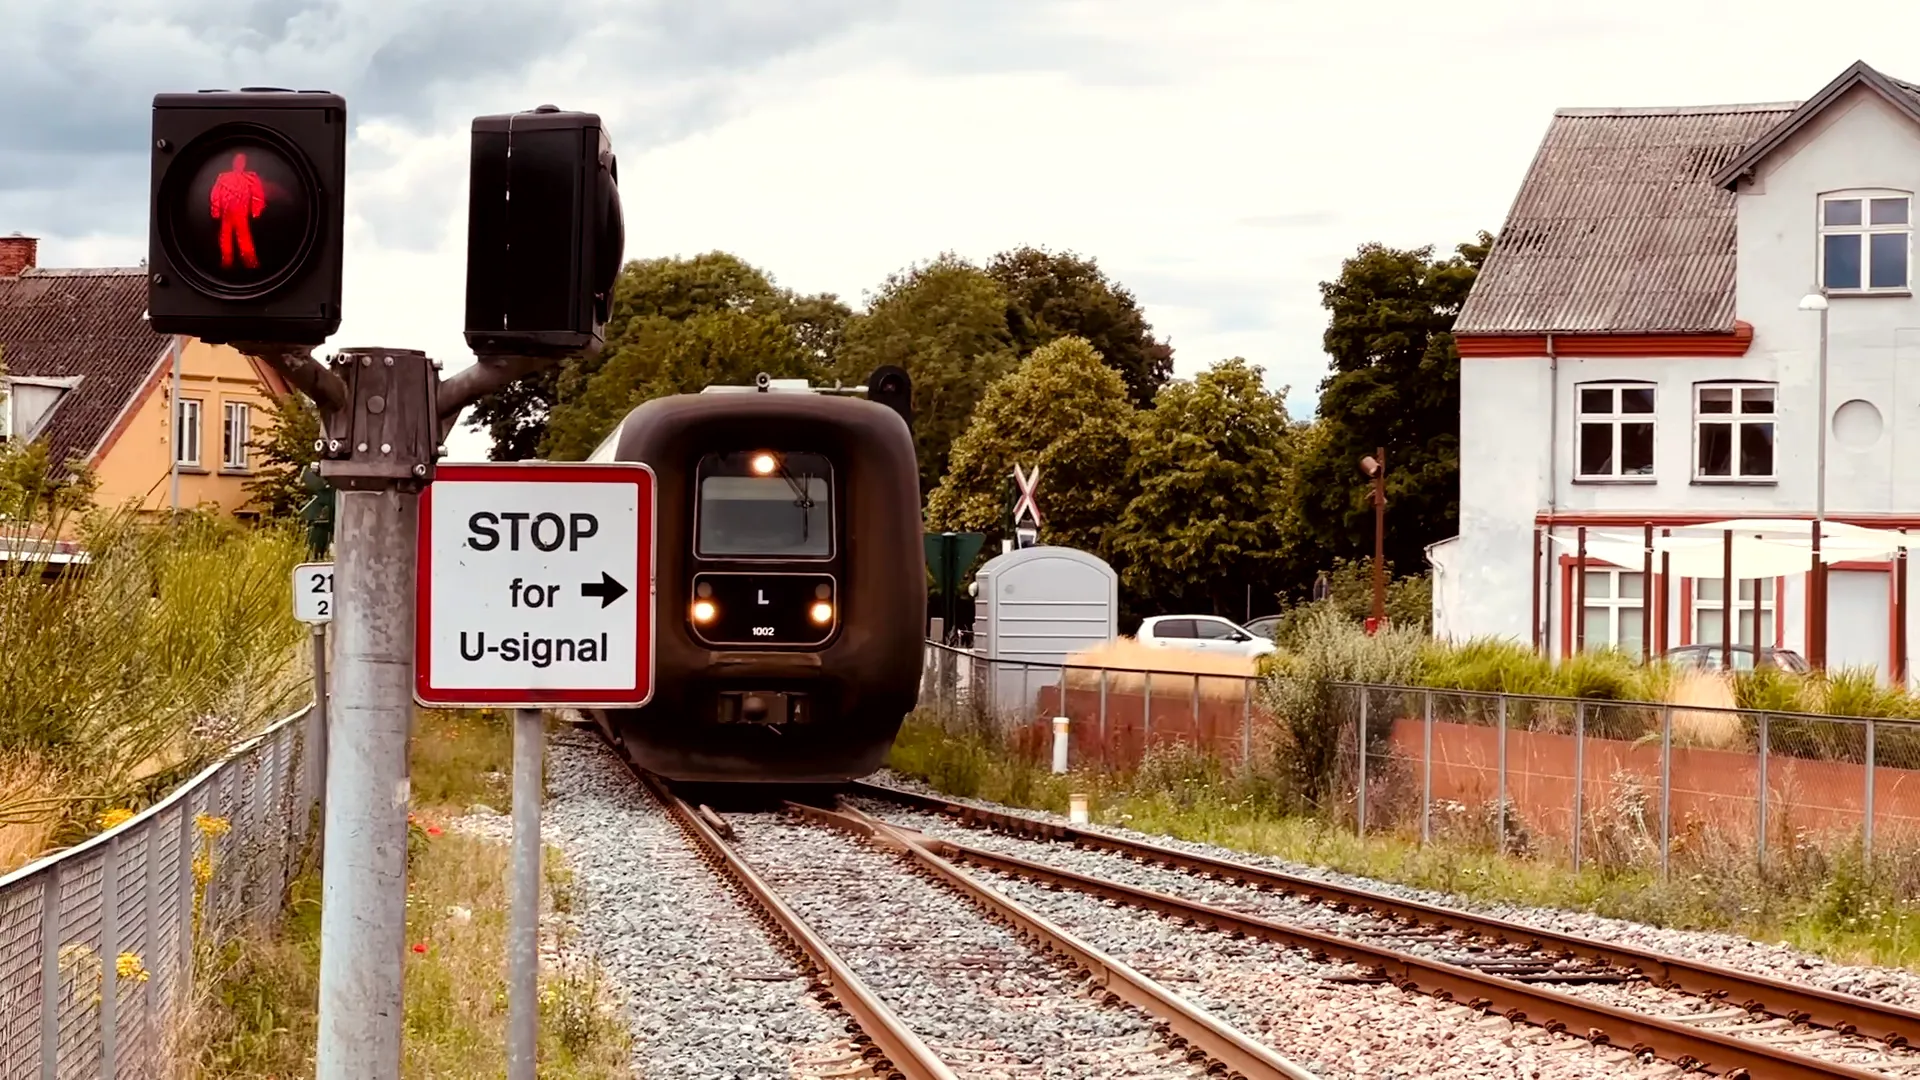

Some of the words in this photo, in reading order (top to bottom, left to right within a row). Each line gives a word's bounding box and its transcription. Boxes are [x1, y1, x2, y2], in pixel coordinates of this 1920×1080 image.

[467, 512, 599, 552] STOP
[311, 573, 334, 593] 21
[509, 578, 561, 608] for
[757, 589, 770, 605] L
[317, 600, 329, 615] 2
[752, 627, 775, 636] 1002
[460, 632, 608, 668] U-signal
